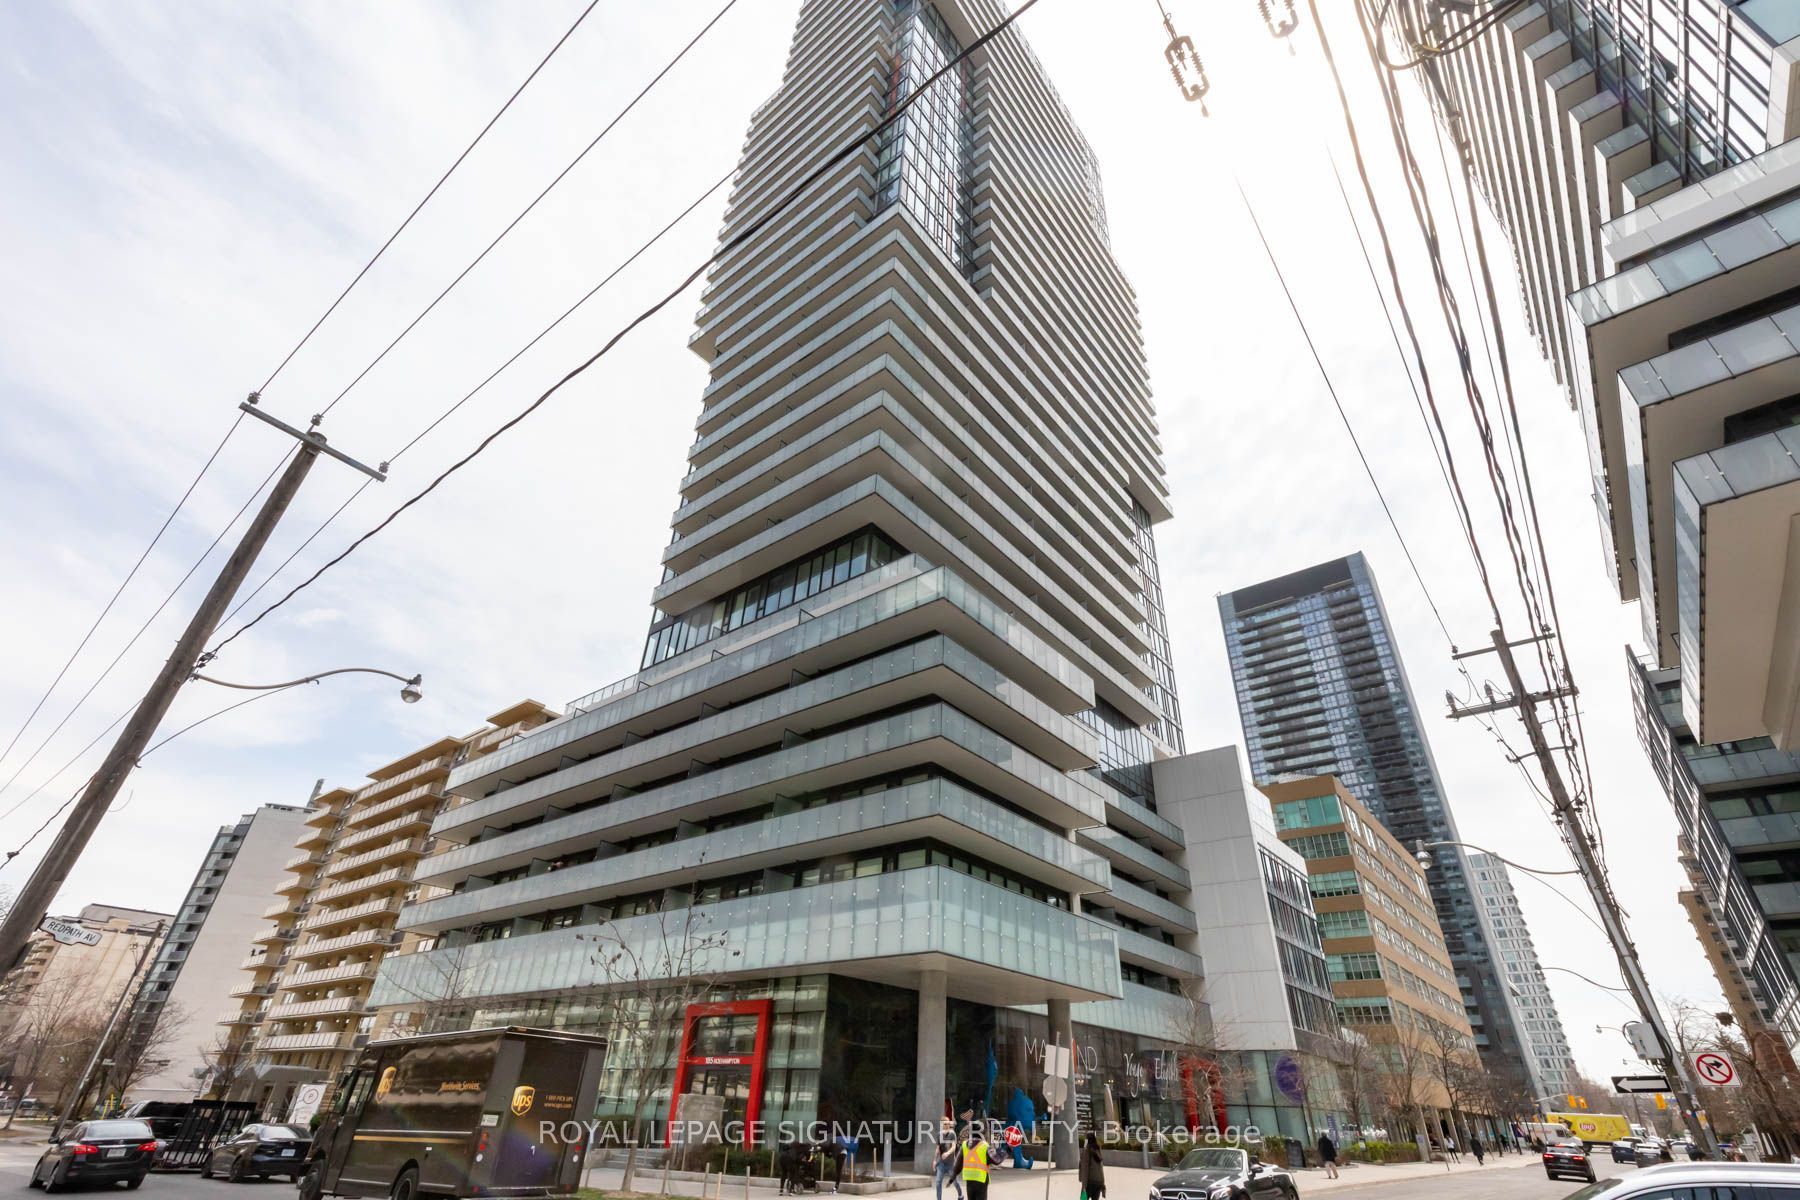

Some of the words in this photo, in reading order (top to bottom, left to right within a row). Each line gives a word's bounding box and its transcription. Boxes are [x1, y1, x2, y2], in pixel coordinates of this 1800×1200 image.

[47, 921, 82, 938] REDPATH
[84, 932, 96, 942] AV
[513, 1095, 532, 1111] ups
[1005, 1129, 1023, 1142] STOP
